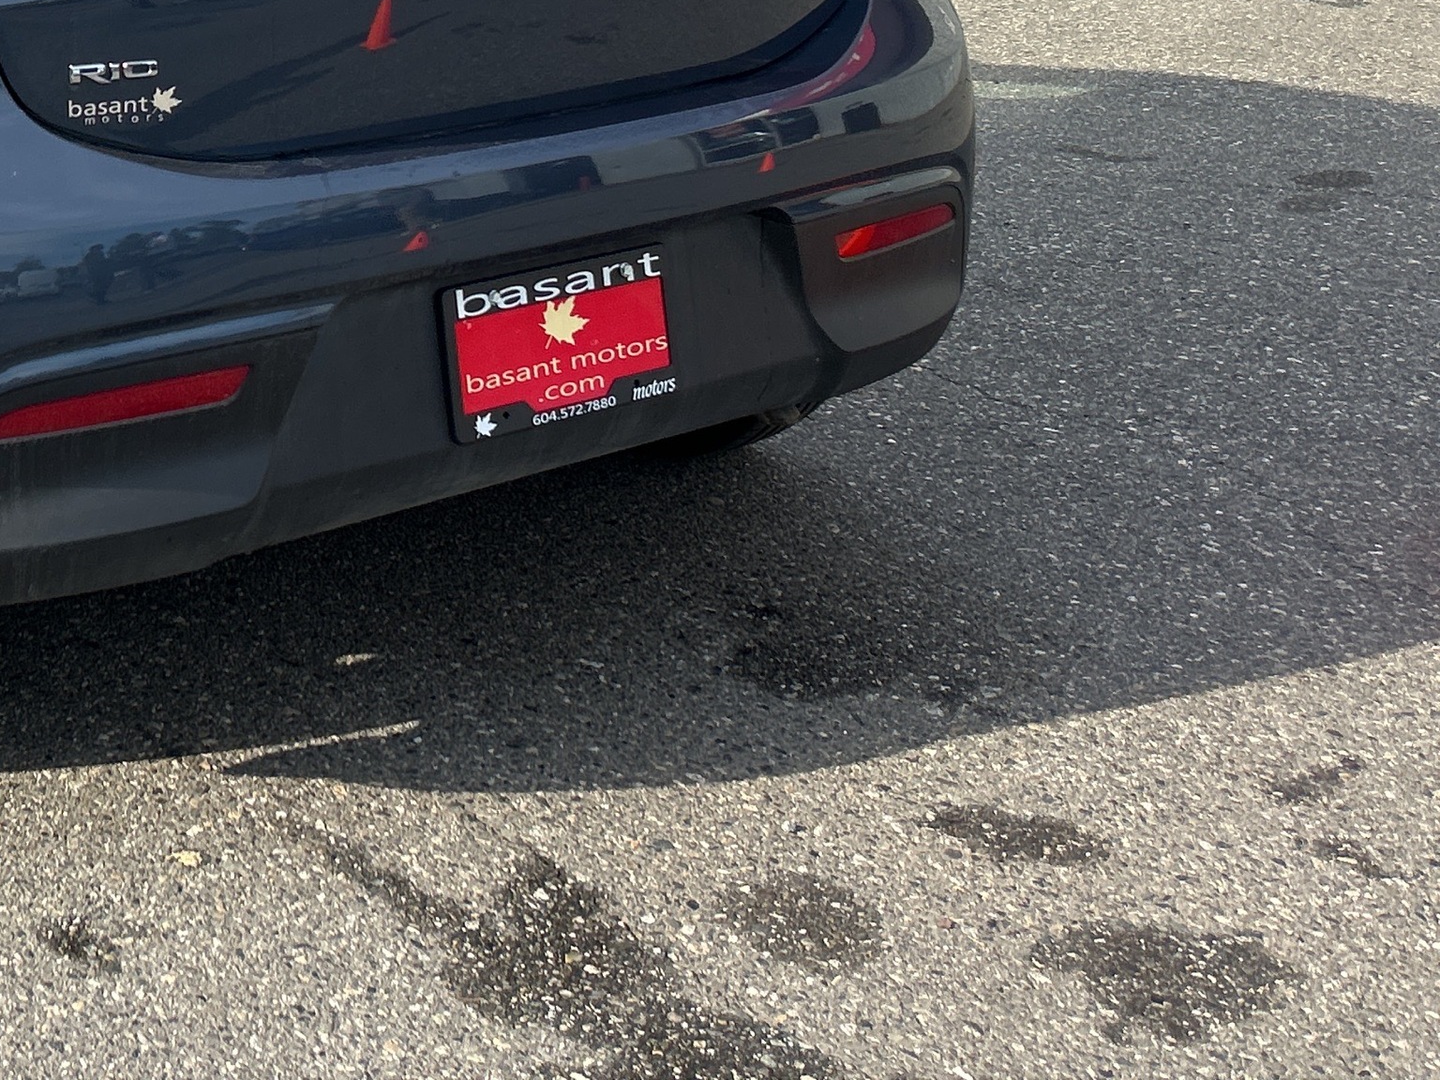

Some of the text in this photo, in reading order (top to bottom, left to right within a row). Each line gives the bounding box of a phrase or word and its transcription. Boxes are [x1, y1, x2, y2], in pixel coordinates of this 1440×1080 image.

[68, 96, 148, 118] basant
[84, 113, 164, 126] motors
[454, 252, 661, 320] basant
[466, 334, 669, 394] basant motors
[538, 373, 605, 402] .com
[632, 376, 676, 401] motors
[532, 395, 617, 426] 604.572.7880
